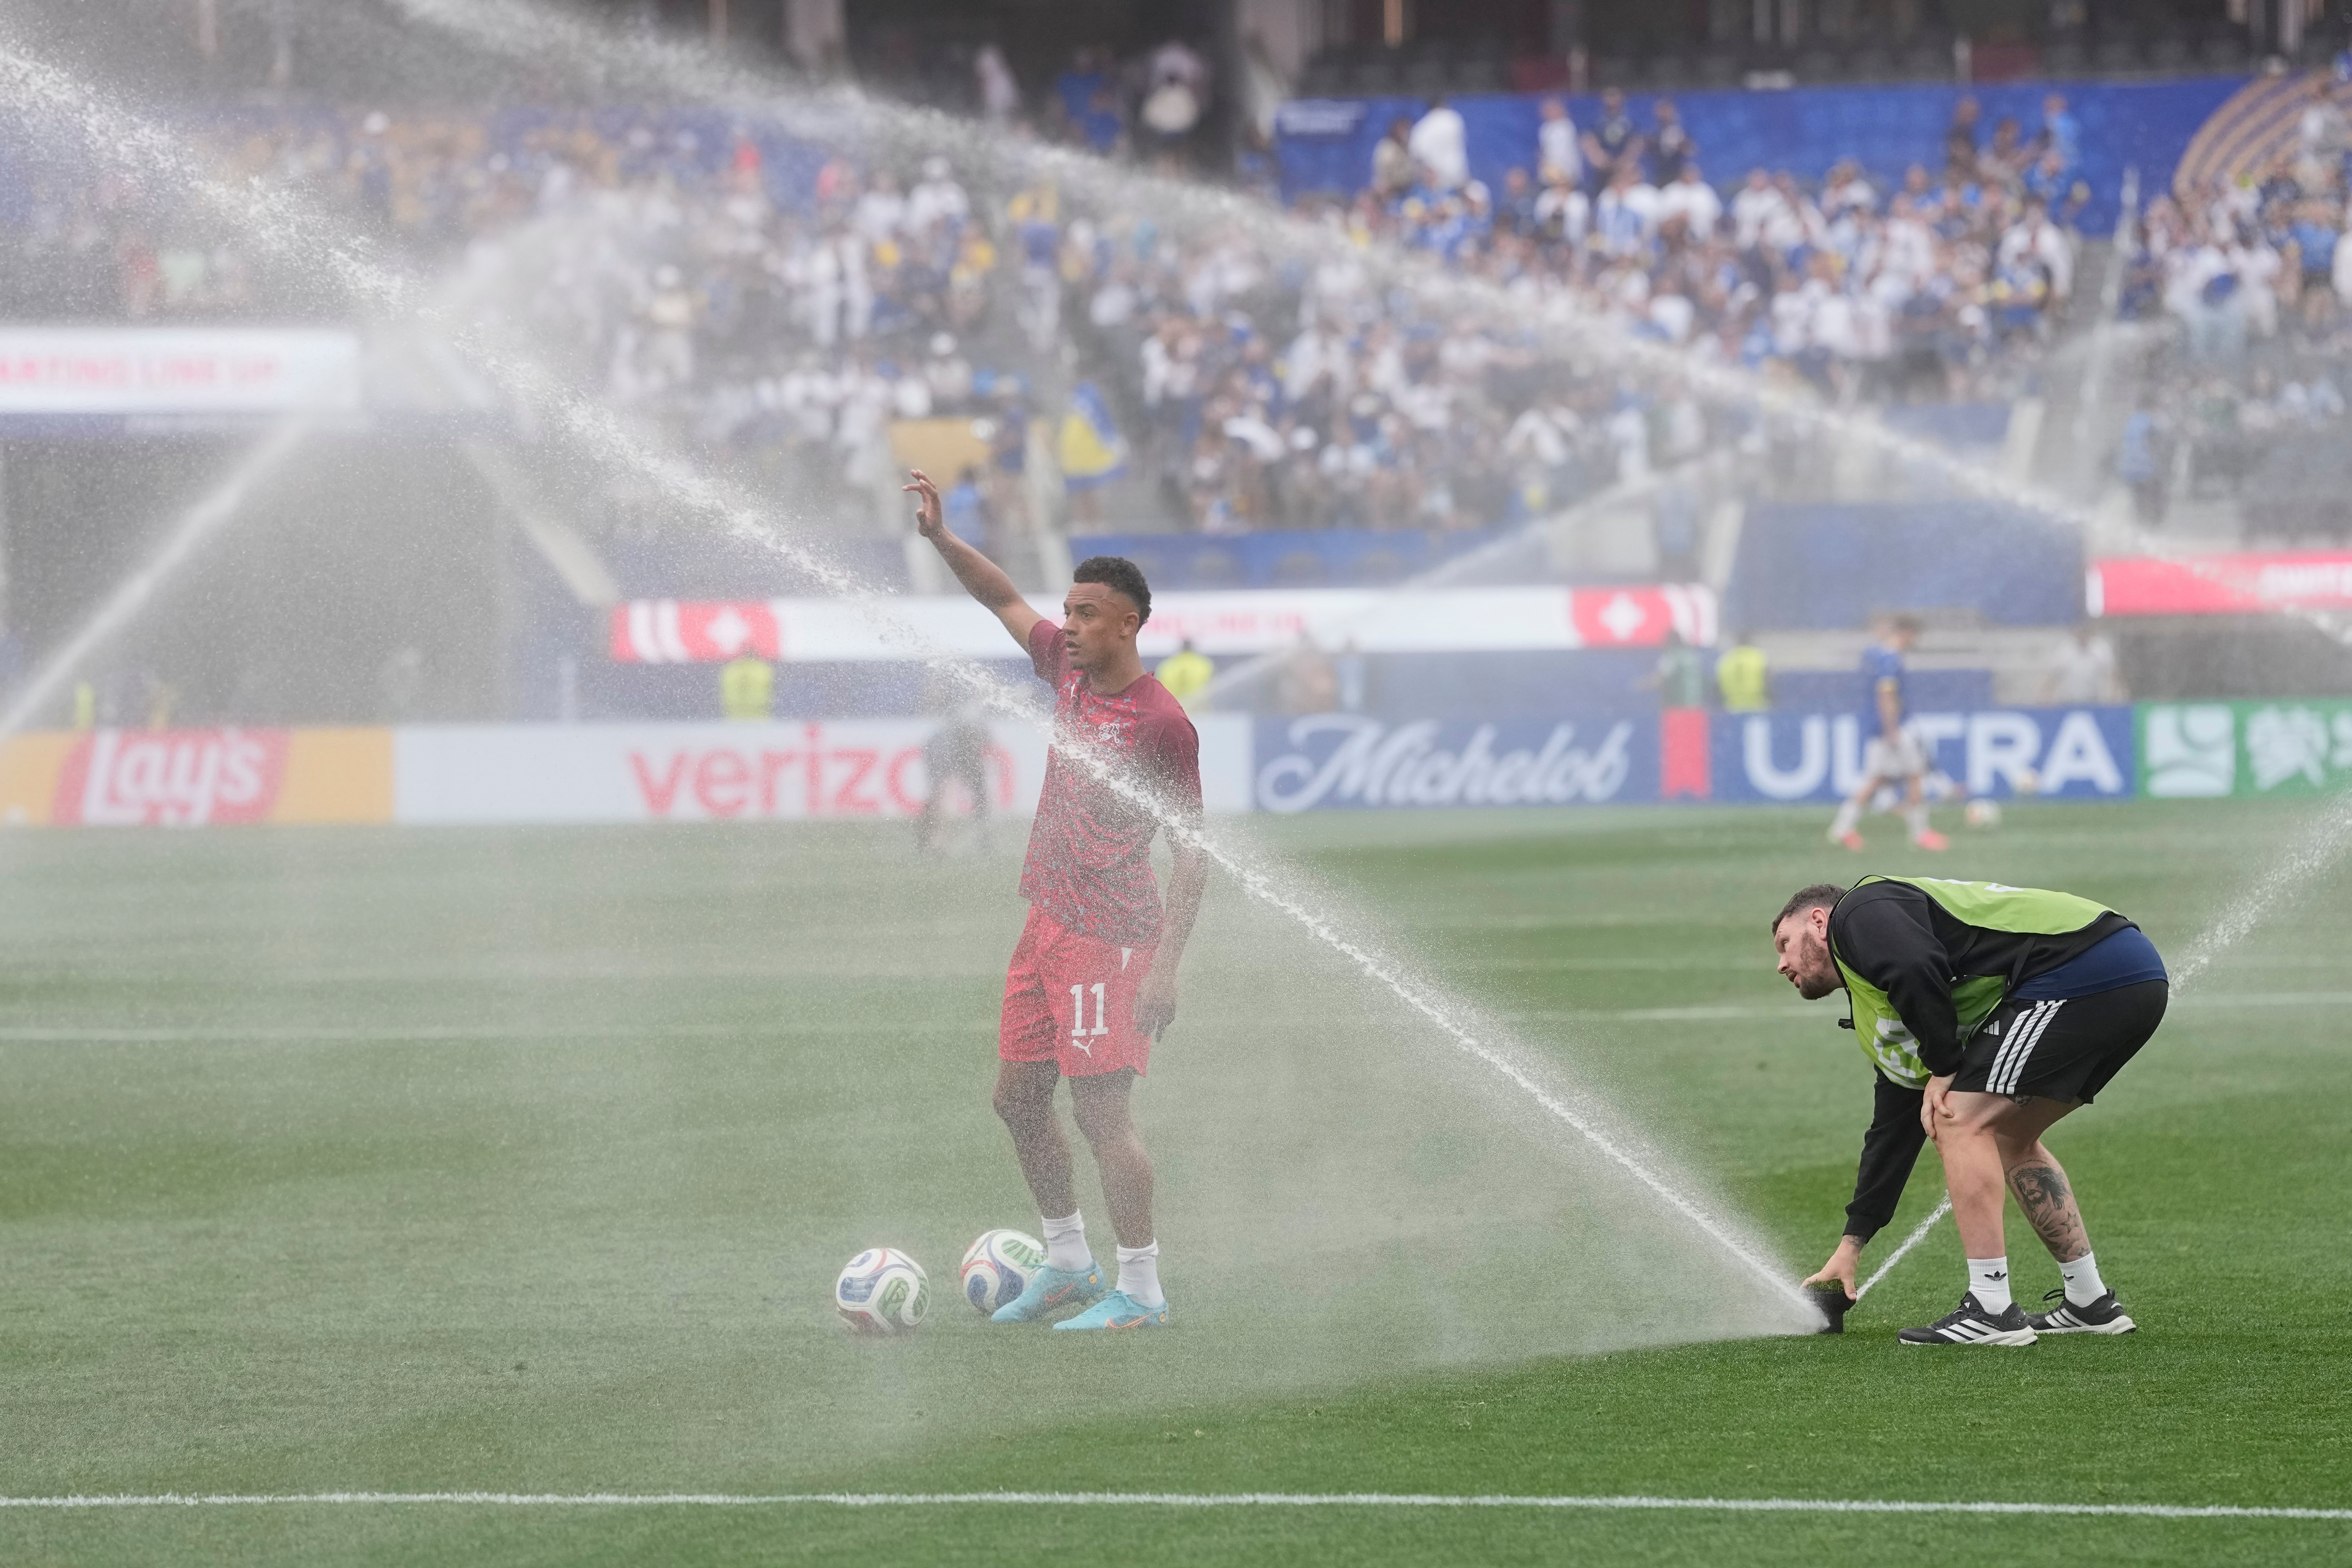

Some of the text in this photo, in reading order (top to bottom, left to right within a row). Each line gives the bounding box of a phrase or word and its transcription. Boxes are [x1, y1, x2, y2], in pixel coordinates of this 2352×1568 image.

[82, 727, 266, 826] Lay's
[1257, 712, 1633, 814] Michelob
[1070, 982, 1108, 1037] 11
